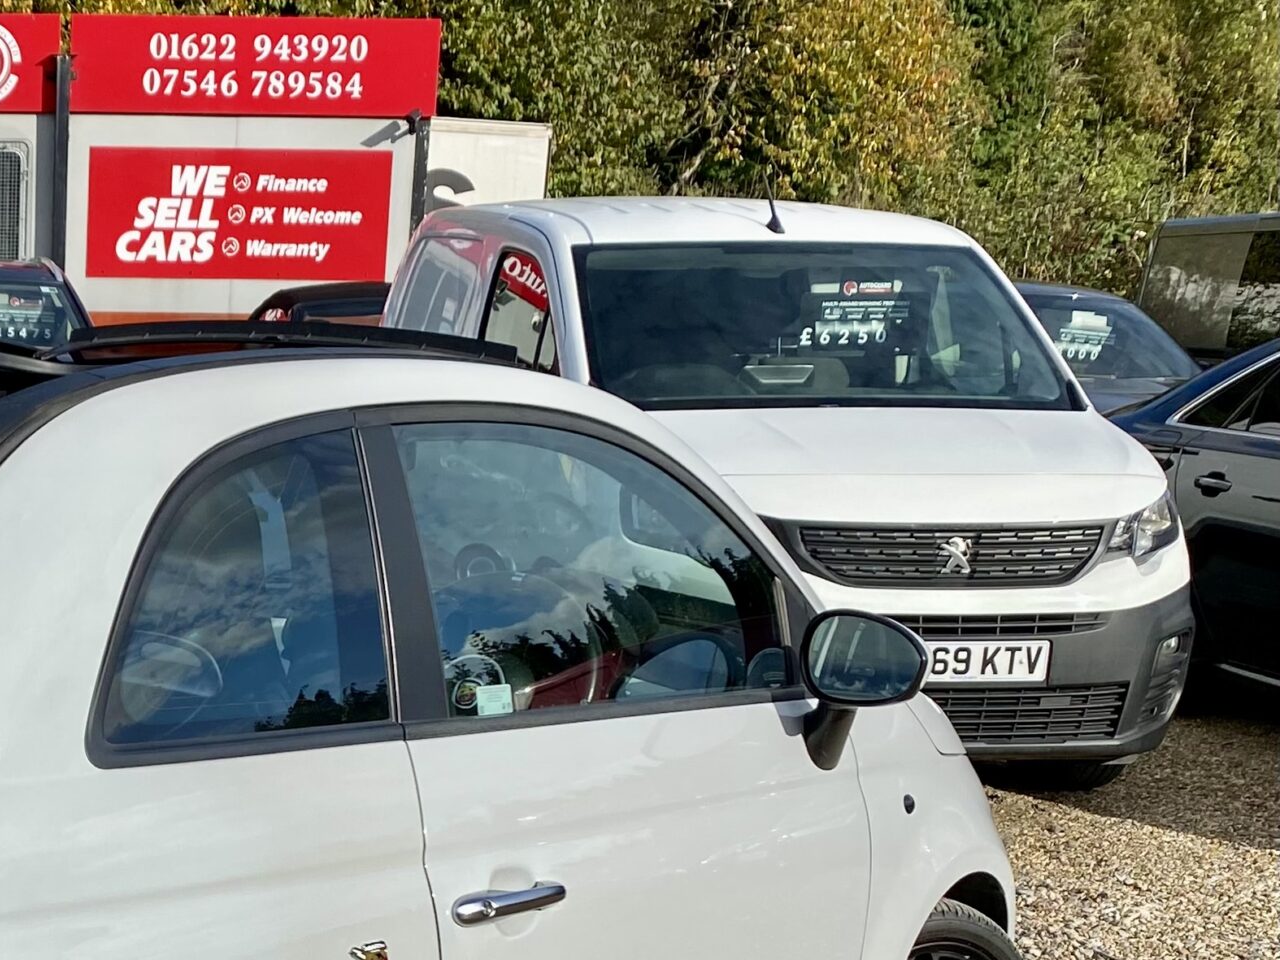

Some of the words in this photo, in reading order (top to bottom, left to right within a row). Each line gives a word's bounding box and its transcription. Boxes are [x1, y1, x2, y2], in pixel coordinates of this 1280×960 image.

[149, 32, 236, 61] 01622
[253, 34, 369, 62] 943920
[142, 68, 239, 97] 07546
[251, 70, 363, 99] 789584
[170, 164, 231, 197] WE
[255, 174, 329, 193] Finance
[133, 196, 220, 230] SELL
[249, 206, 276, 225] PX
[282, 207, 363, 226] Welcome
[115, 229, 217, 264] CARS
[245, 239, 331, 262] Warranty
[799, 326, 887, 346] £6250
[930, 646, 972, 676] 69
[980, 646, 1043, 675] KTV
